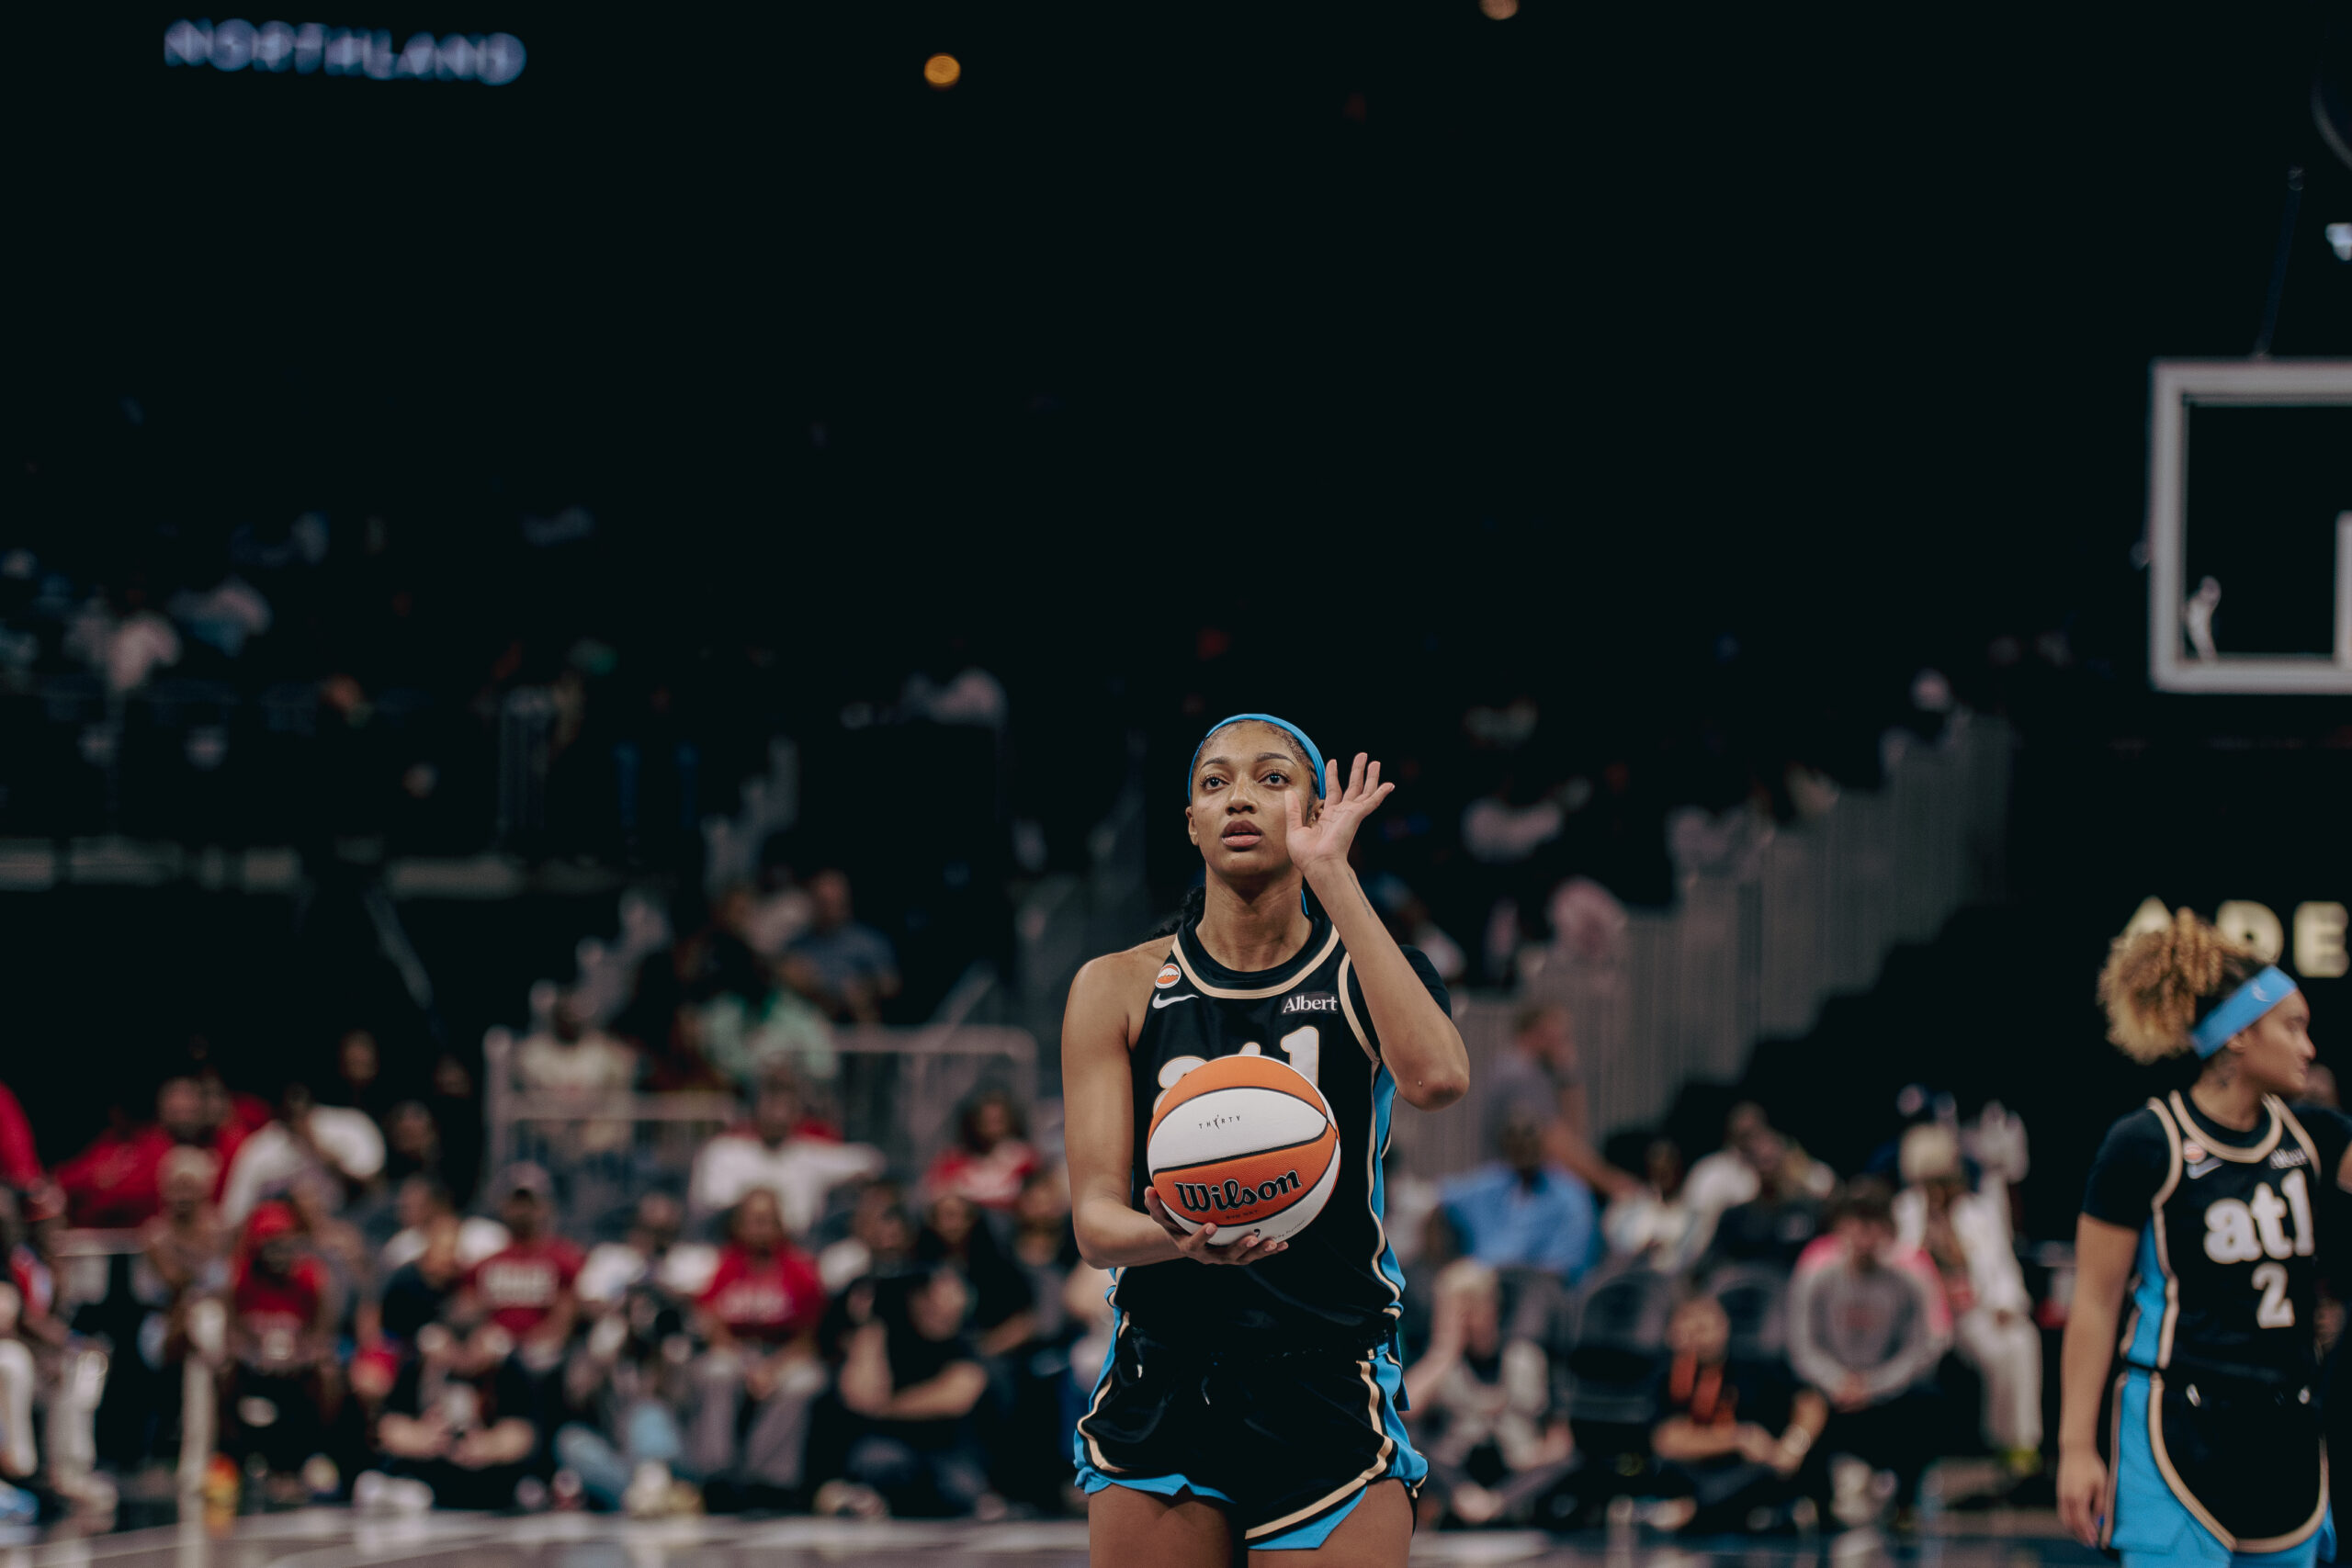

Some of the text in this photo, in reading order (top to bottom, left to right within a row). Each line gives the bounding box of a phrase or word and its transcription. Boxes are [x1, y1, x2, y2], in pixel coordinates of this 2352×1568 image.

[2118, 895, 2349, 978] DE
[1283, 995, 1338, 1013] Albert
[1174, 1169, 1302, 1213] Wilson
[2203, 1168, 2314, 1265] atl
[2252, 1261, 2295, 1329] 2
